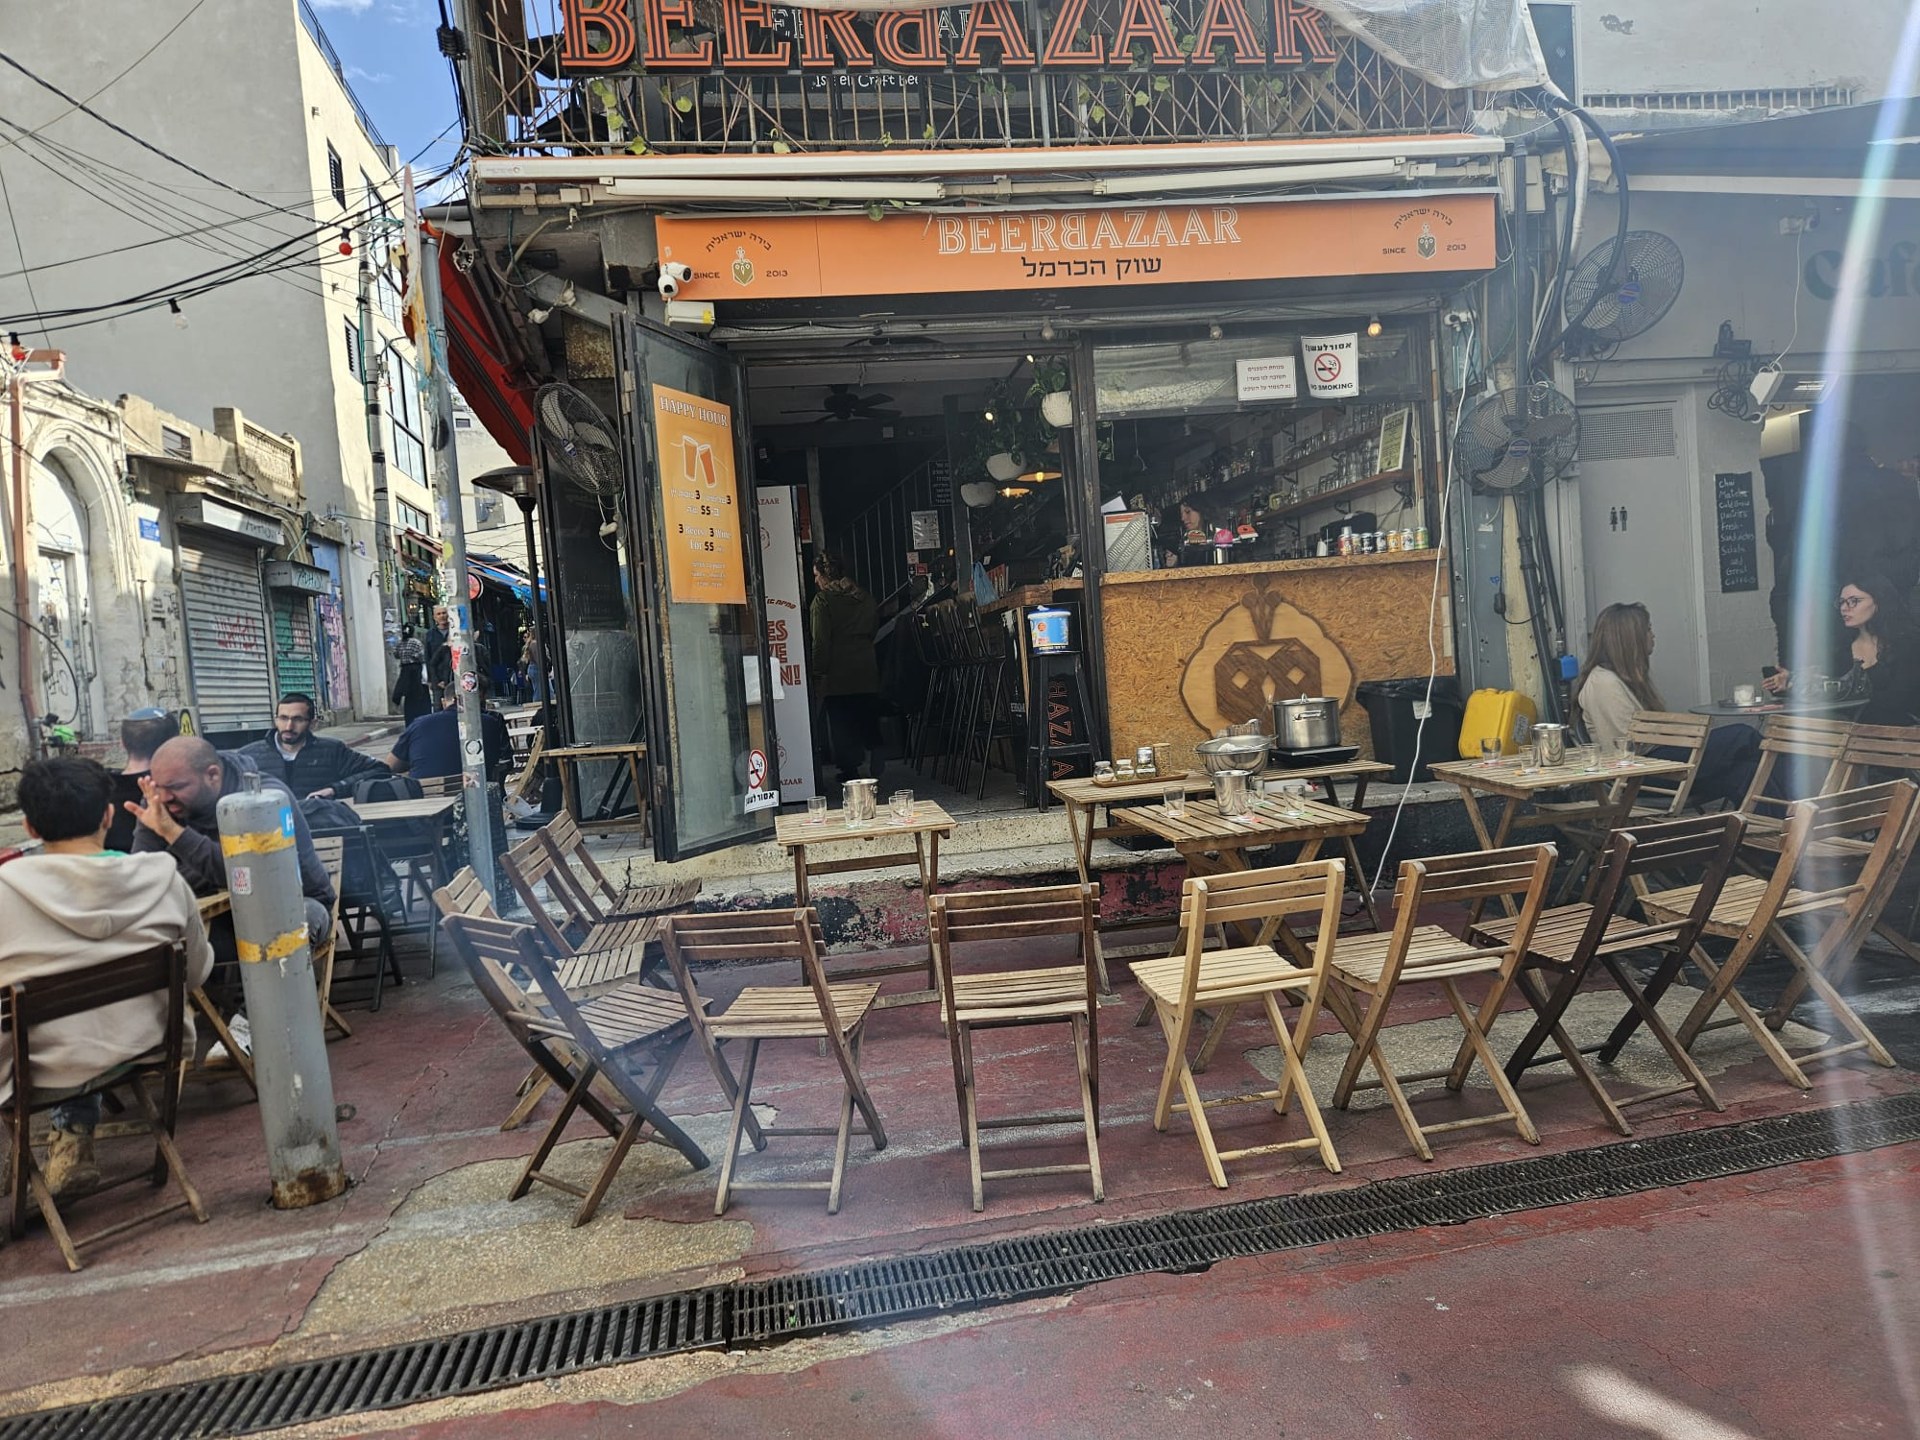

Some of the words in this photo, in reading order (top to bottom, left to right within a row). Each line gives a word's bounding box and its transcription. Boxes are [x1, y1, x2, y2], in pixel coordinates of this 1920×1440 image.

[561, 0, 1336, 67] BEERBAZAAR
[1393, 207, 1431, 230] ישראלית
[1432, 209, 1454, 226] בירה
[705, 230, 747, 253] ישראלית
[749, 232, 772, 251] בירה
[936, 206, 1242, 255] BEERBAZAAR
[1382, 247, 1406, 255] SINCE
[1446, 243, 1467, 252] 2013
[693, 271, 720, 280] SINCE
[766, 269, 788, 278] 2013
[1022, 256, 1106, 278] הכרמל
[1115, 257, 1162, 280] שוק
[1803, 239, 1920, 301] Caf
[1318, 382, 1354, 390] SMOKING
[659, 396, 696, 418] HAPPY
[698, 407, 729, 427] HOUR
[704, 541, 715, 552] 55
[757, 791, 775, 801] אסור
